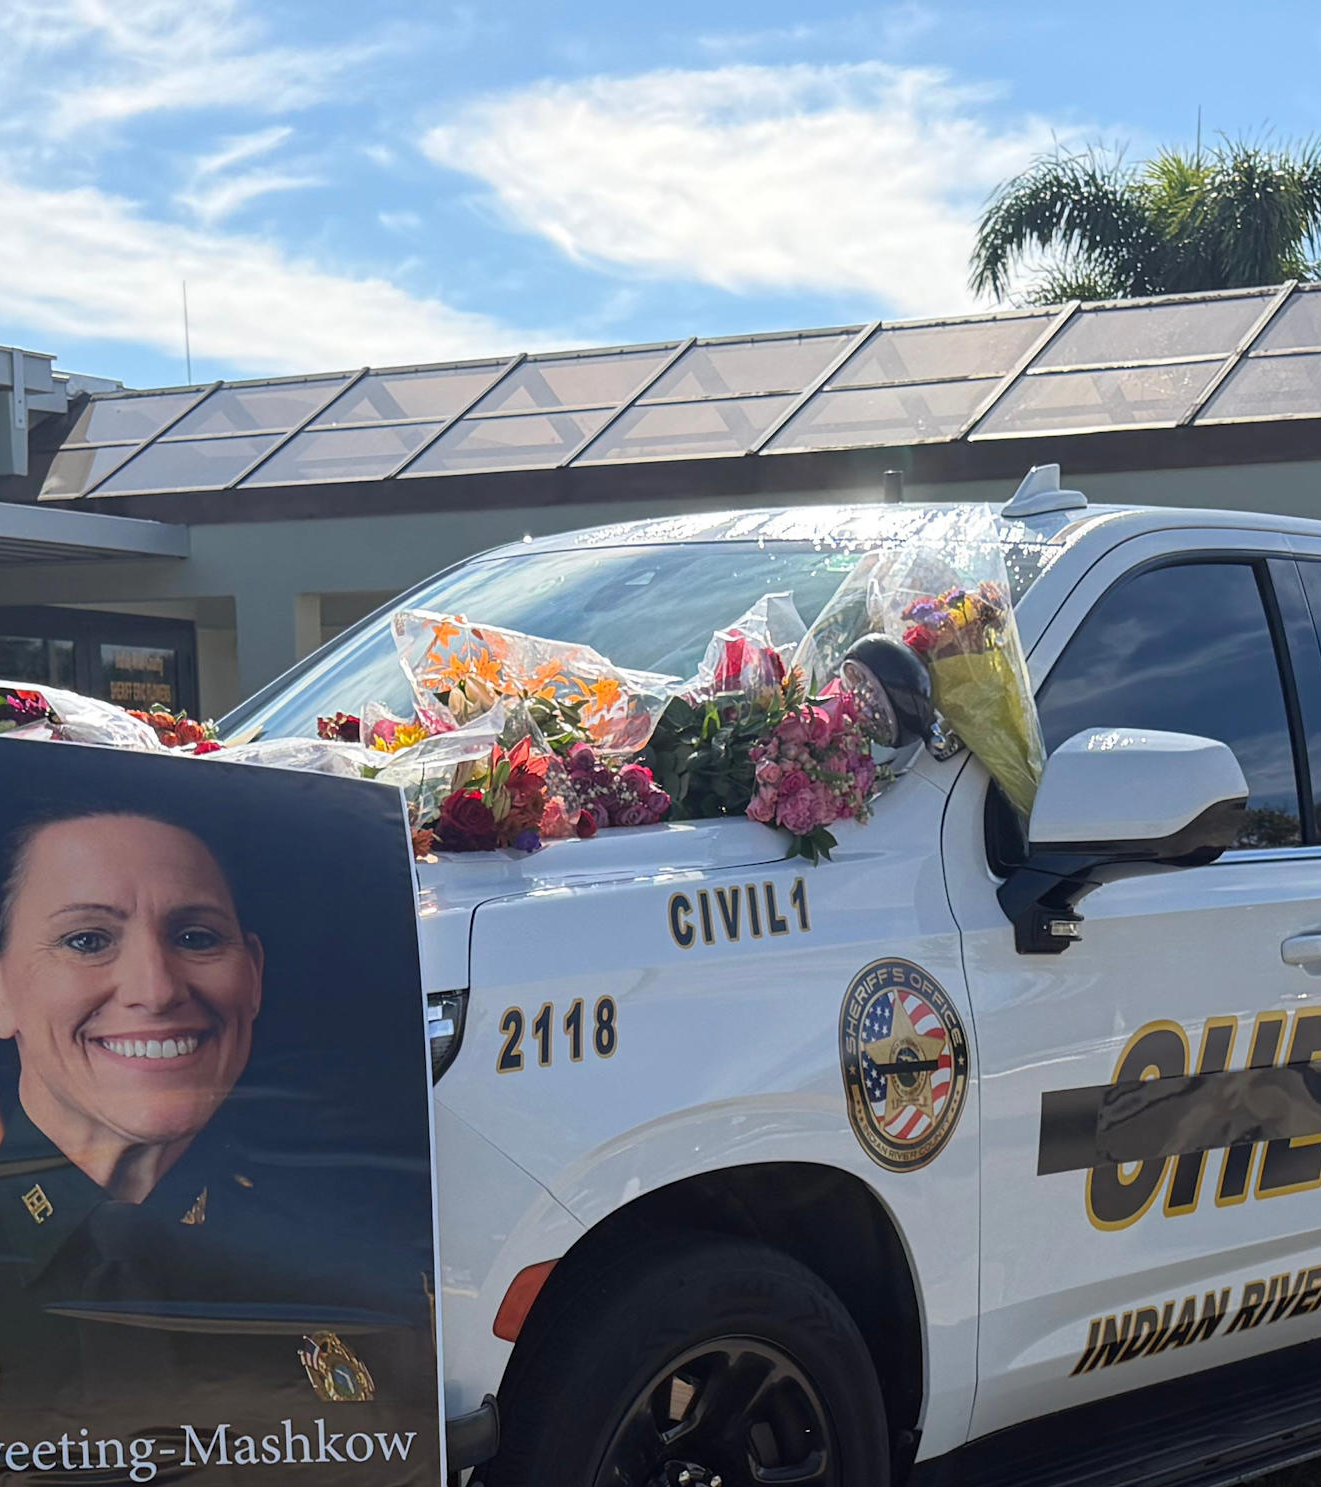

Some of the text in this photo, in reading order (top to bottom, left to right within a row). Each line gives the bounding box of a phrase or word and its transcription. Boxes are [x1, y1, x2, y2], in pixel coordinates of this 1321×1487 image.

[496, 994, 618, 1075] 2118
[845, 967, 964, 1056] SHERIFF'S OFFICE
[1069, 1287, 1231, 1377] INDIAN
